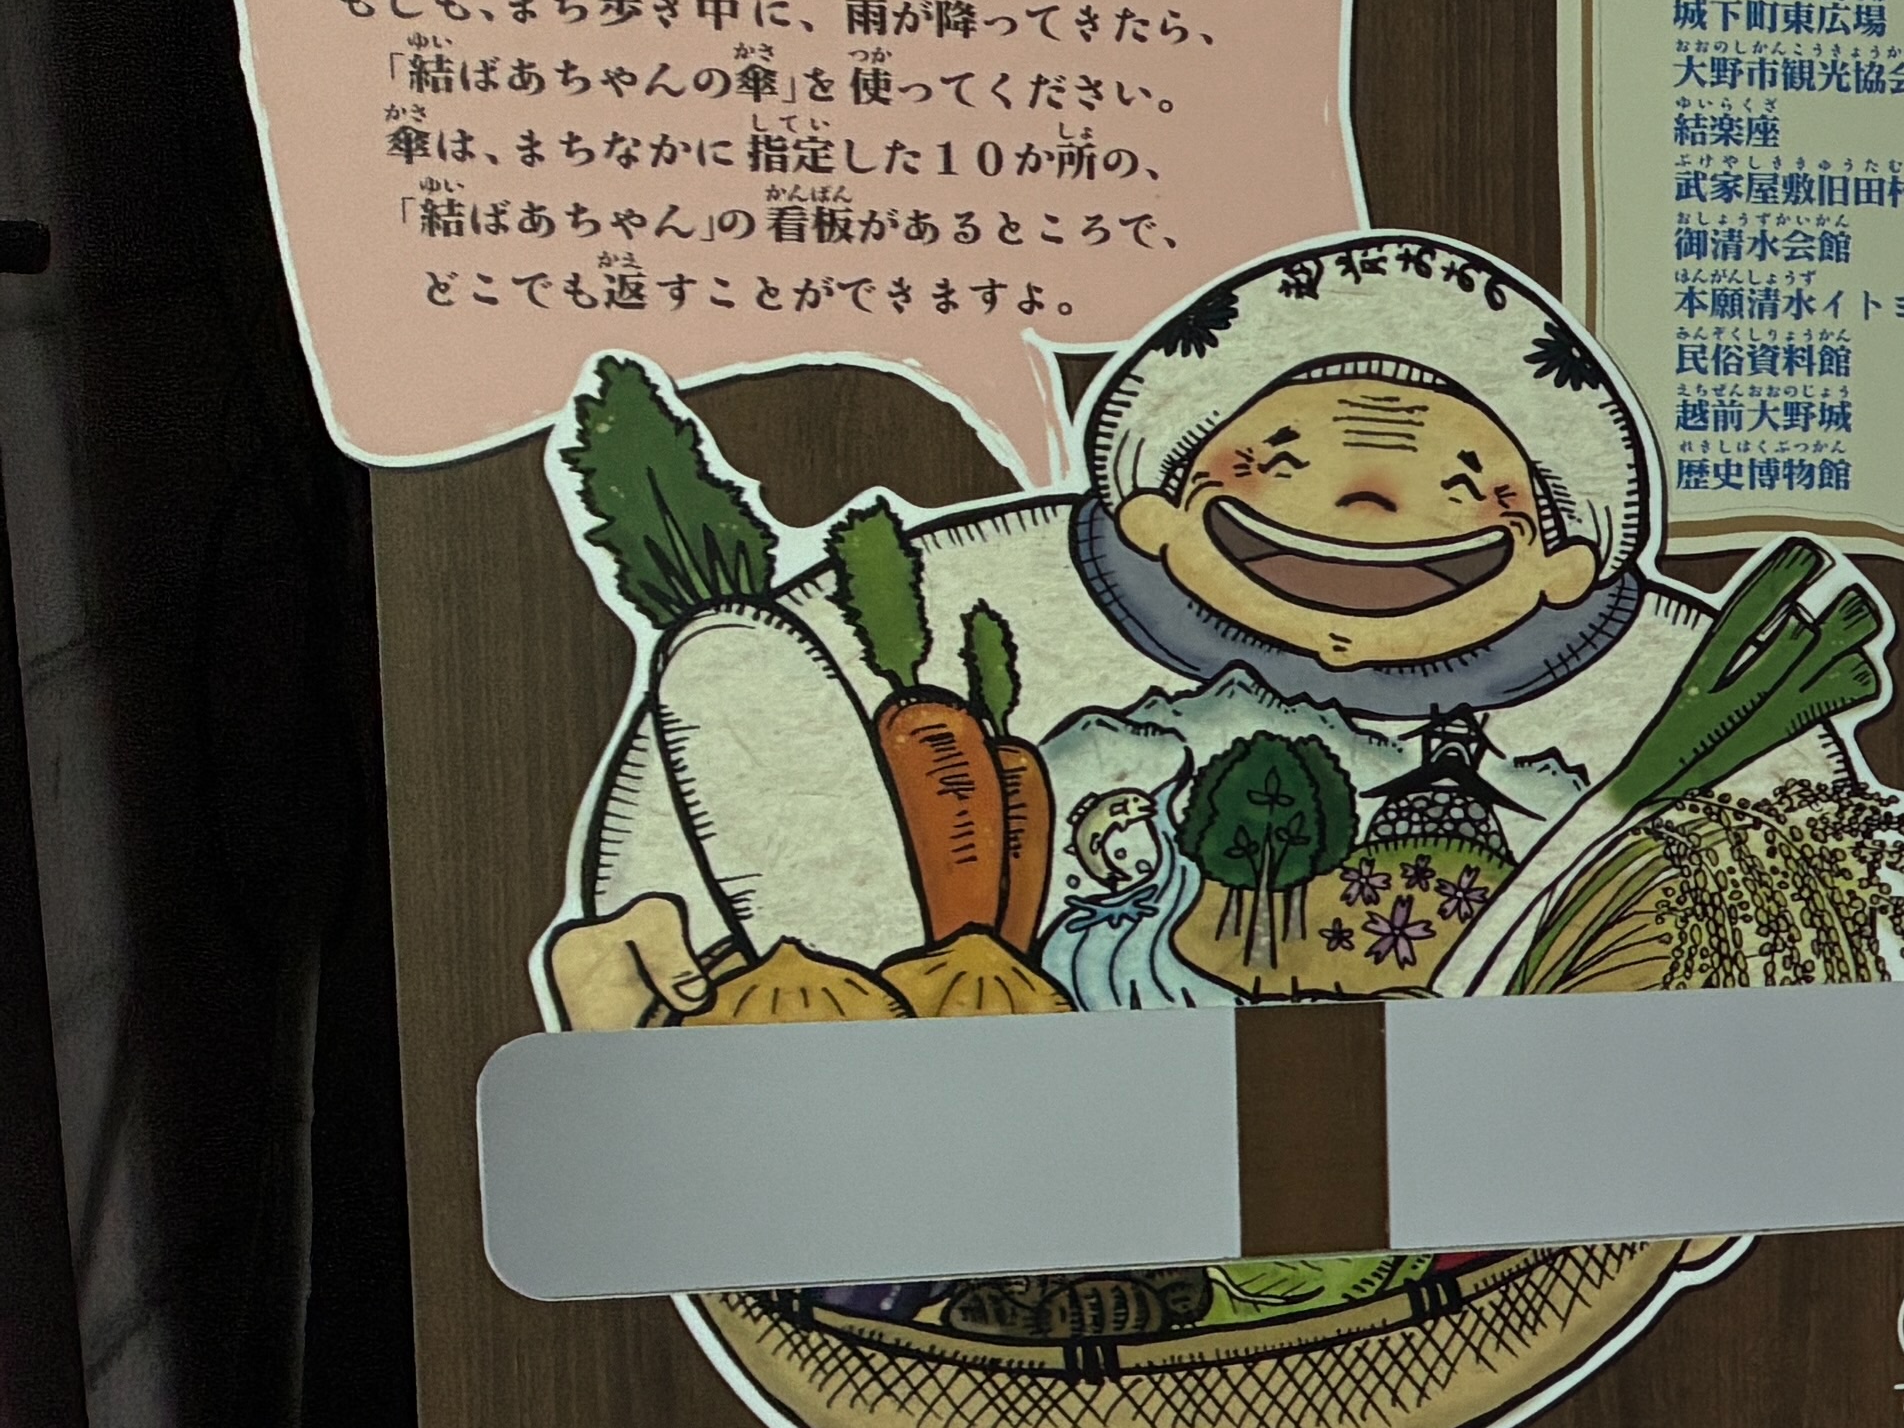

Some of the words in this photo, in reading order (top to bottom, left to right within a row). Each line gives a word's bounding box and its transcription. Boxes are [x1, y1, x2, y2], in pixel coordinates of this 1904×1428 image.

[405, 31, 455, 51] ゆい
[731, 40, 778, 63] かさ
[846, 45, 895, 65] つか
[388, 51, 1175, 115] 「結ばあちゃんの傘」を使ってください。
[382, 101, 428, 122] かさ
[750, 112, 832, 134] してい
[1056, 120, 1095, 141] しょ
[1673, 114, 1781, 148] 結楽座
[384, 124, 1161, 183] 傘は、まちなかに指定した10か所の、
[417, 175, 467, 195] ゆい
[764, 183, 854, 205] かんばん
[400, 196, 1179, 252] 「結ばあちゃん」の看板があるところで、
[595, 249, 645, 270] かえ
[1674, 228, 1852, 263] 御清水会館
[424, 270, 1075, 318] どこでも返すことができますよ。
[1675, 343, 1852, 378] 民俗資料館
[1675, 400, 1852, 433] 越前大野城
[1675, 458, 1852, 491] 歴史博物館
